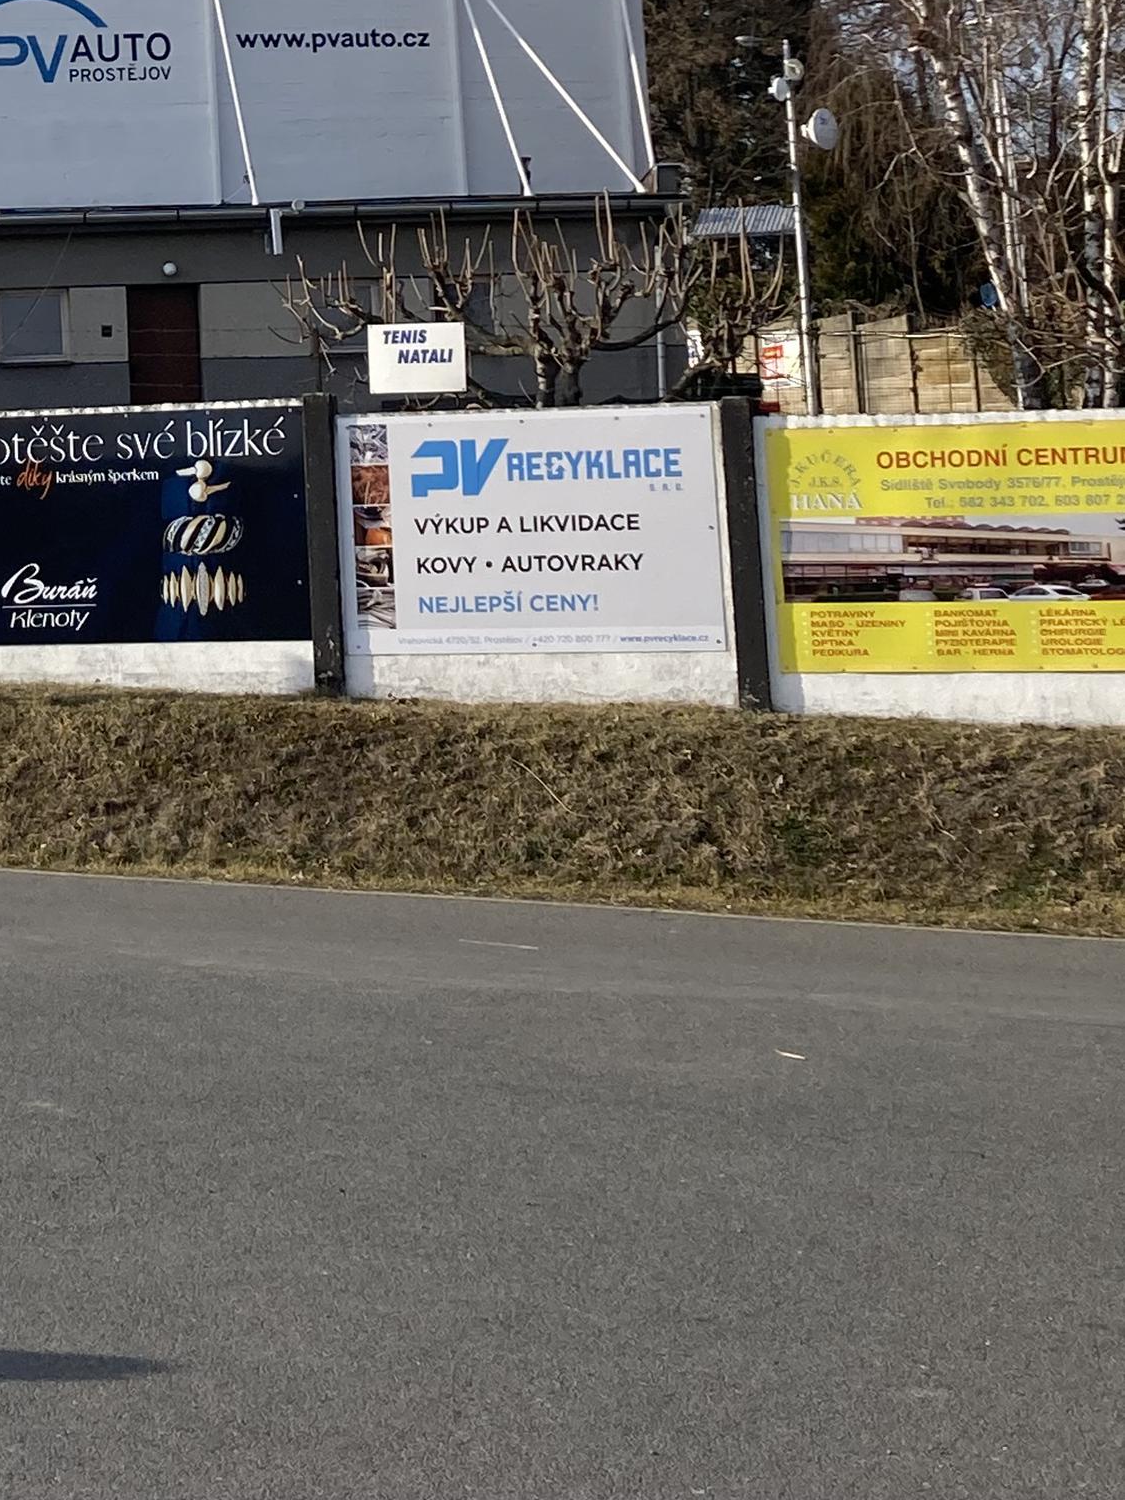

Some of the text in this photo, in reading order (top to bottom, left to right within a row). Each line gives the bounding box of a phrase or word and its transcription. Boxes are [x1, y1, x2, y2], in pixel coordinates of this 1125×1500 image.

[236, 28, 431, 53] www.pvauto.cz
[69, 63, 172, 83] PROSTĚJOV
[383, 329, 427, 344] TENIS
[397, 348, 453, 364] NATALI
[116, 420, 175, 460] své
[186, 416, 286, 459] blízké
[411, 438, 509, 497] PV
[876, 444, 1125, 469] OBCHODNÍ CENTRU
[55, 470, 106, 486] krásným
[415, 514, 641, 534] VÝKUP A LIKVIDACE
[416, 553, 644, 574] KOVY AUTOVRAKY
[1, 563, 98, 604] Buráň
[418, 591, 599, 614] NEJLEPŠÍ CENY!
[10, 609, 90, 631] Klenoty
